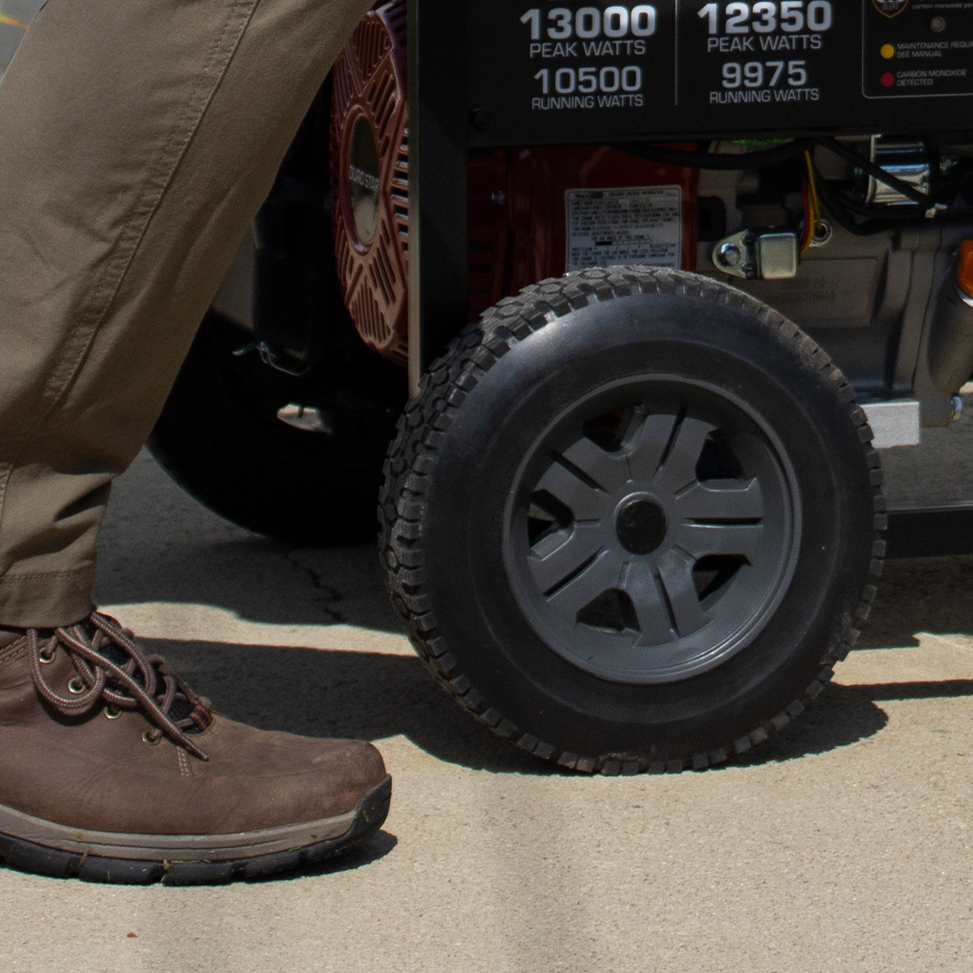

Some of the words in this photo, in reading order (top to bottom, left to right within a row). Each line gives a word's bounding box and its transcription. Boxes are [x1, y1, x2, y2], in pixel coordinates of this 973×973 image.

[882, 2, 899, 11] ALERT
[520, 5, 656, 40] 13000
[697, 0, 832, 34] 12350
[530, 41, 577, 58] PEAK
[582, 39, 646, 57] WATTS
[708, 36, 755, 53] PEAK
[760, 33, 822, 51] WATTS
[897, 41, 949, 50] MAINTENANCE
[897, 50, 911, 58] SEE
[911, 49, 943, 57] MANUAL
[534, 65, 642, 94] 10500
[722, 61, 807, 89] 9975
[897, 70, 927, 78] CARBON
[928, 69, 967, 77] MONOXIDE
[897, 78, 933, 87] DETECTED
[532, 94, 594, 110] RUNNING
[597, 93, 643, 108] WATTS
[709, 89, 771, 105] RUNNING
[774, 87, 820, 103] WATTS
